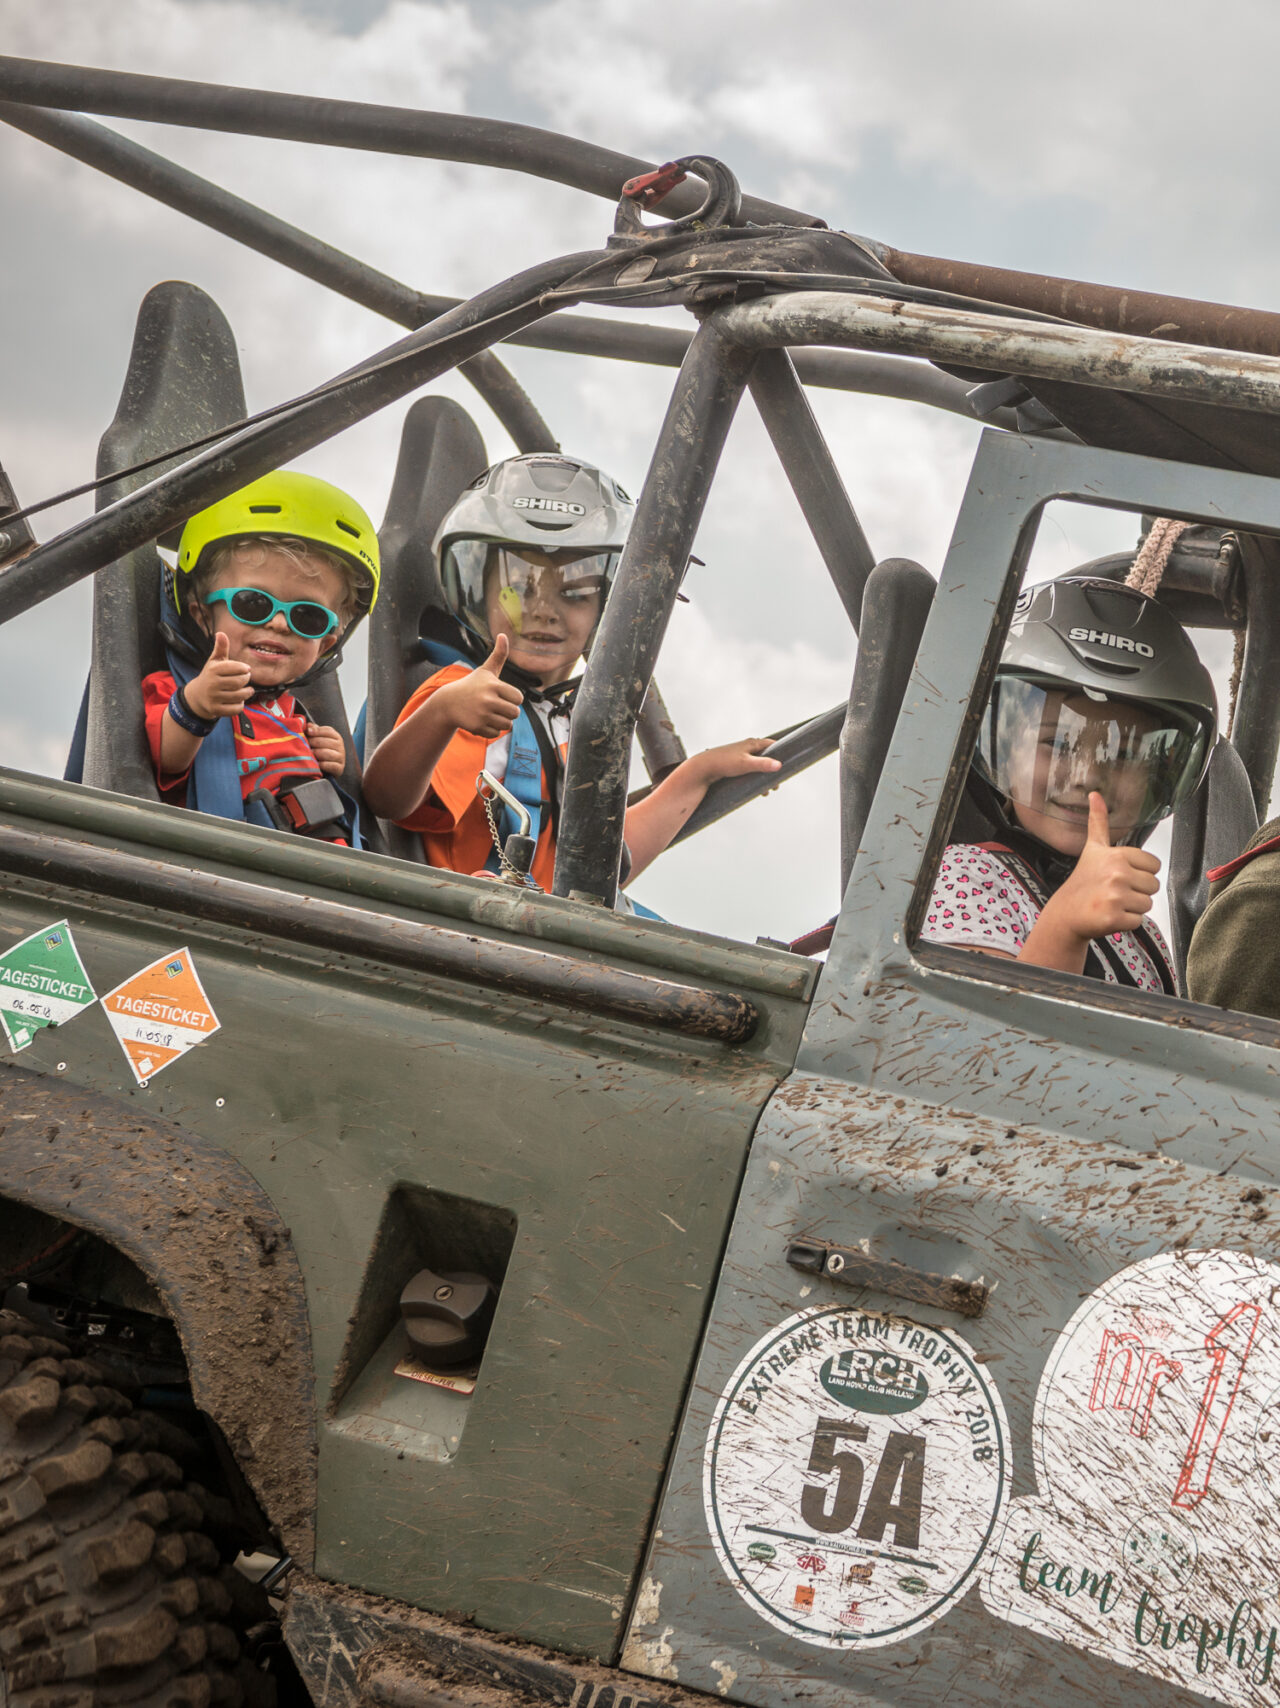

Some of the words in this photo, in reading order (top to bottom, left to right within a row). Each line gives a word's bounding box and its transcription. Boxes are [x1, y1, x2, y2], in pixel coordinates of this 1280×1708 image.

[513, 497, 586, 516] SHIRO
[1068, 627, 1155, 659] SHIRO
[116, 995, 210, 1028] TAGESTICKET
[738, 1326, 823, 1415] EXTREME
[829, 1316, 890, 1340] TEAM
[899, 1324, 977, 1398] TROPHY
[965, 1405, 993, 1462] 2018
[828, 1376, 846, 1387] LAND
[885, 1387, 915, 1400] HOLLAND
[829, 1351, 920, 1391] LRCH
[1172, 1302, 1262, 1511] 1
[800, 1417, 926, 1550] 5A
[797, 1554, 827, 1574] SAS
[1018, 1532, 1123, 1614] team
